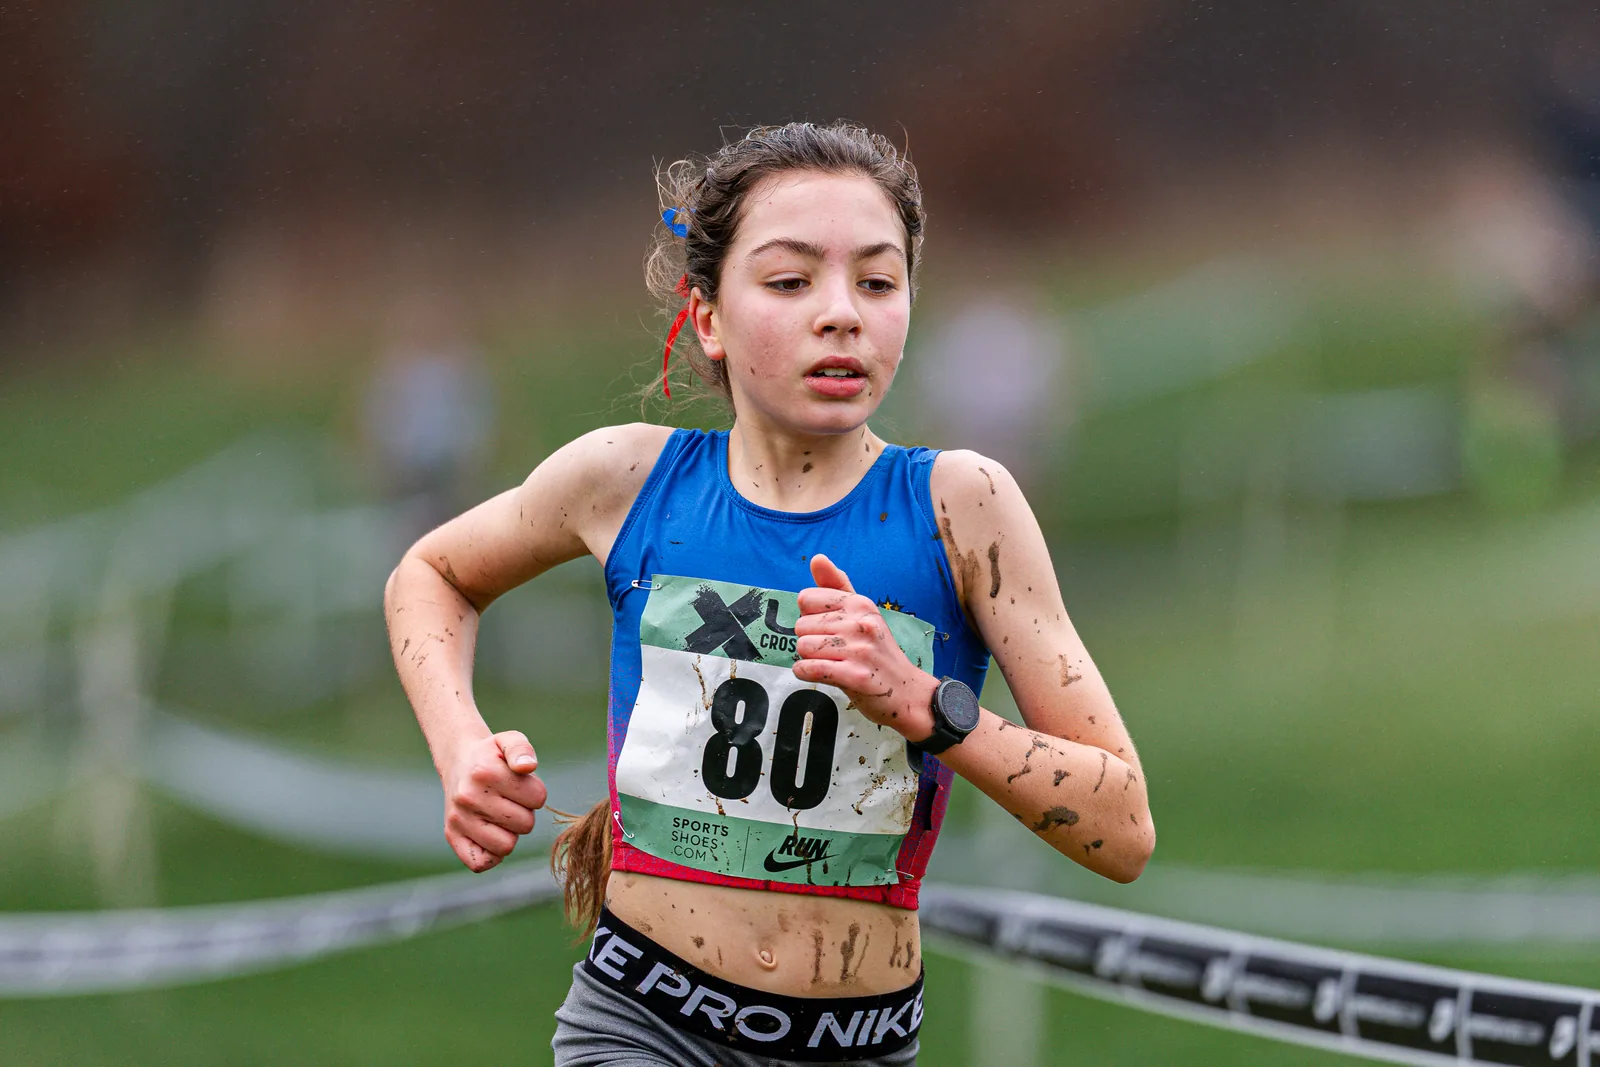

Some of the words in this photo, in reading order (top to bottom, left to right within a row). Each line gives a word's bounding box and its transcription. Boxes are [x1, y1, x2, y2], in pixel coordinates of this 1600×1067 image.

[760, 633, 798, 653] CROS
[701, 677, 839, 810] 80
[672, 817, 729, 837] SPORTS
[671, 830, 718, 849] SHOES
[778, 835, 831, 859] RUN
[635, 961, 792, 1042] PRO
